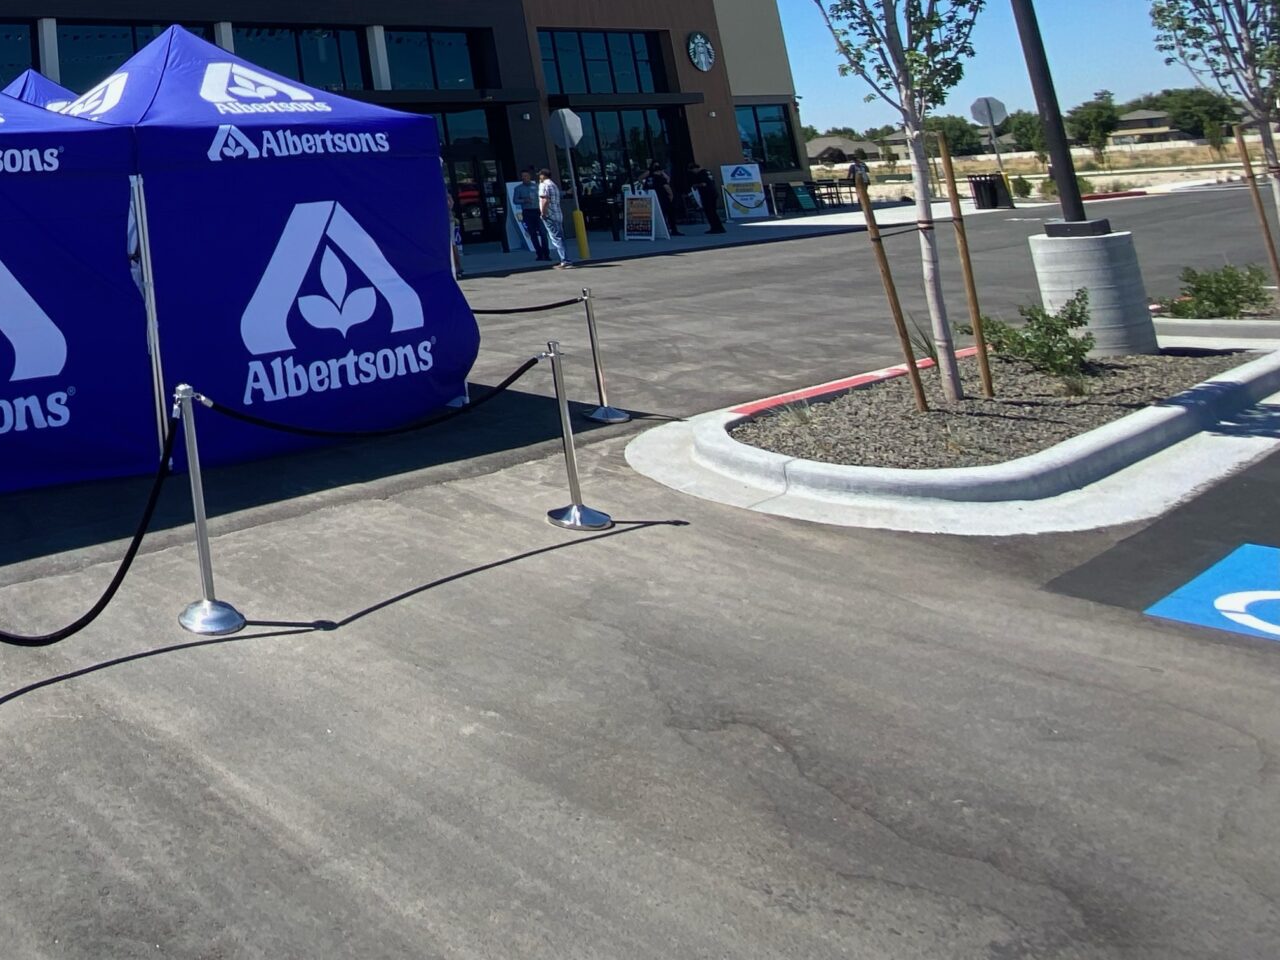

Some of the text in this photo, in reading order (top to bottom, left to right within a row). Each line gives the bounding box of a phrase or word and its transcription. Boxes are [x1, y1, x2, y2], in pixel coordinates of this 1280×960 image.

[214, 101, 332, 115] Albertsons
[261, 129, 390, 158] Albertsons
[242, 340, 434, 406] Albertsons
